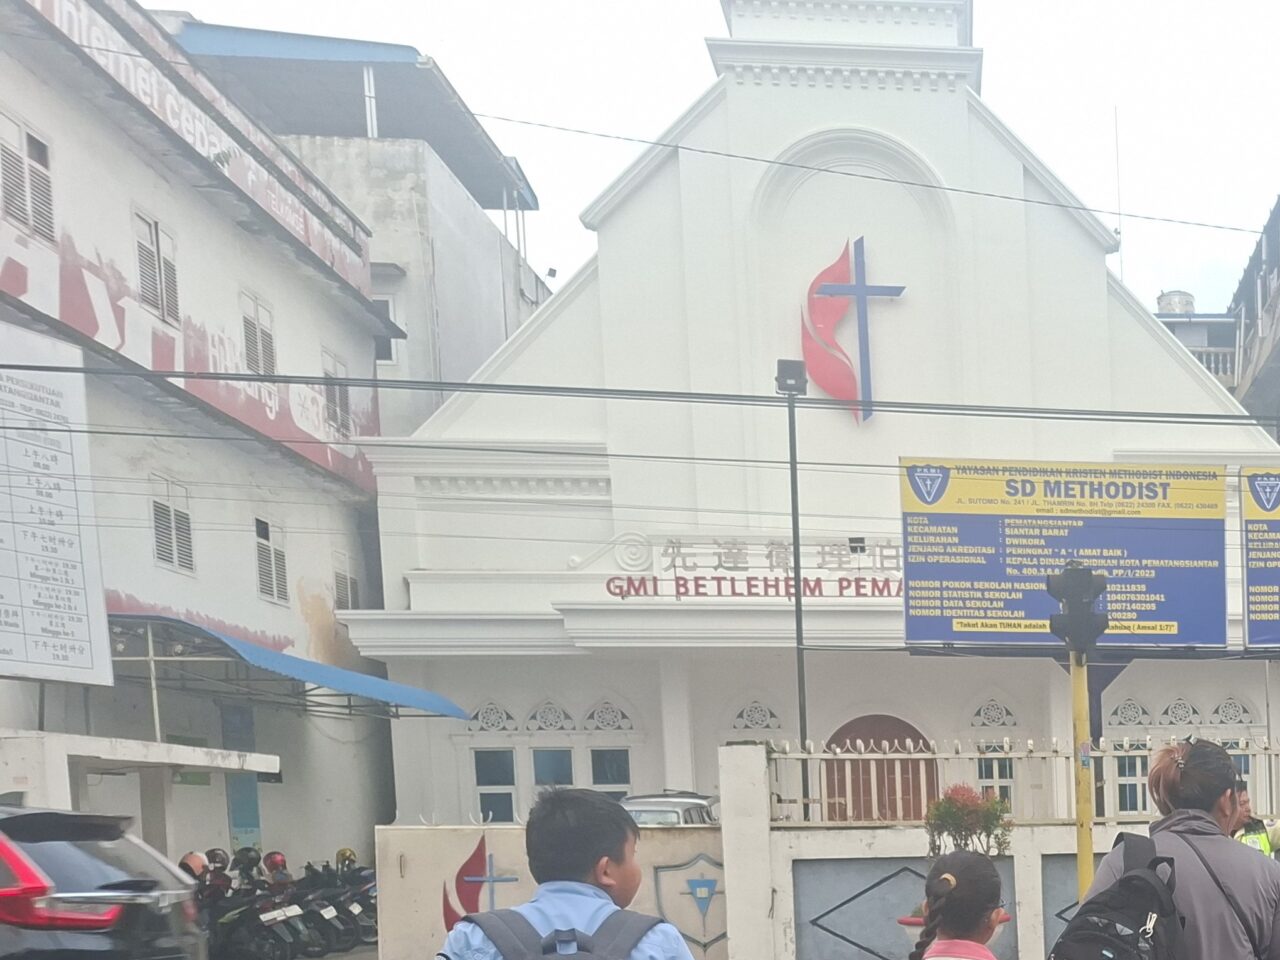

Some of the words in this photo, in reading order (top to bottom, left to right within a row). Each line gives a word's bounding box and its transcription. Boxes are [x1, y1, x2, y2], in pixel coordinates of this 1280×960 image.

[1109, 469, 1163, 480] METHODIST
[1166, 471, 1218, 481] INDONESIA
[1005, 479, 1036, 497] SD
[1044, 481, 1171, 500] METHODIST
[908, 526, 958, 534] KECAMATAN
[1005, 528, 1040, 536] SIANTAR
[1042, 529, 1069, 537] BARAT
[908, 535, 959, 544] KELURAHAN
[1006, 537, 1046, 545] DWIKORA
[946, 546, 996, 554] AKREDITASI
[1006, 547, 1053, 556] PERINGKAT
[1006, 557, 1039, 565] KEPALA
[1120, 560, 1140, 568] KOTA
[1142, 560, 1219, 568] PEMATANGSIANTAR
[606, 576, 659, 597] GMI
[675, 577, 824, 597] BETLEHEM
[942, 581, 972, 589] POKOK
[974, 581, 1012, 589] SEKOLAH
[909, 590, 941, 598] NOMOR
[943, 591, 983, 599] STATISTIK
[984, 591, 1023, 599] SEKOLAH
[943, 600, 964, 608] DATA
[910, 609, 941, 617] NOMOR
[943, 609, 985, 617] IDENTITAS
[987, 610, 1025, 618] SEKOLAH
